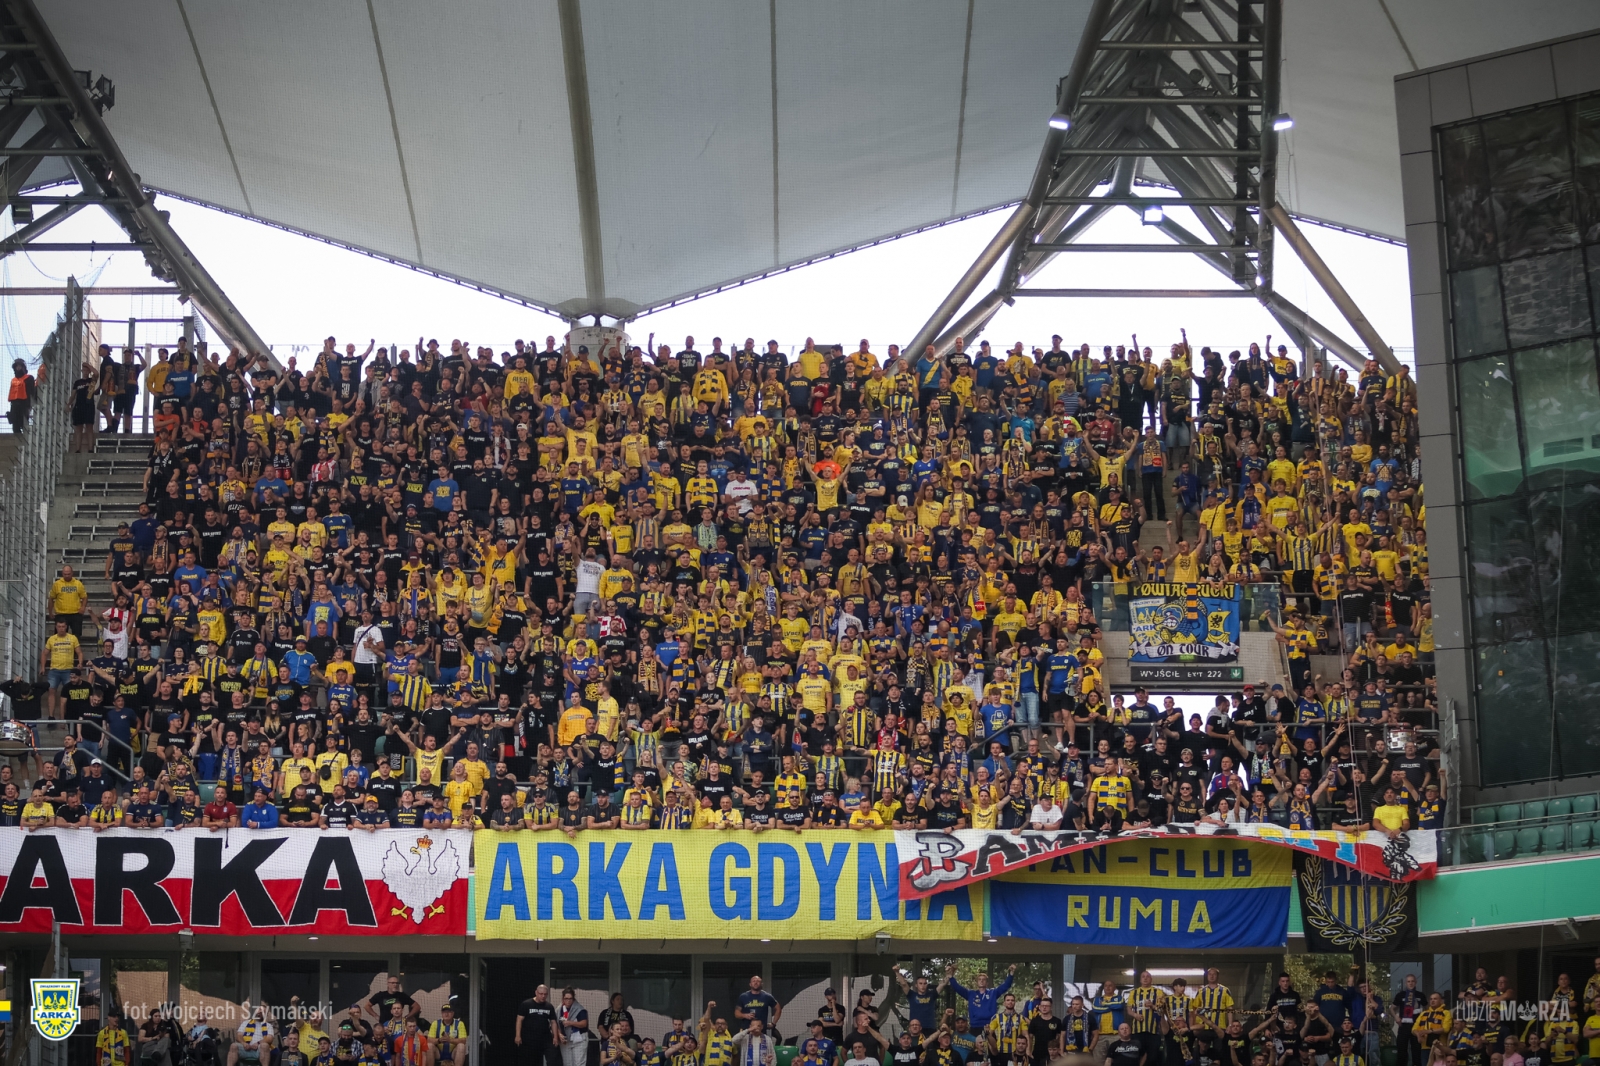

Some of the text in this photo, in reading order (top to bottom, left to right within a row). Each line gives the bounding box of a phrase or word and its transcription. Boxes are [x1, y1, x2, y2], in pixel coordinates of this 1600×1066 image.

[1140, 669, 1180, 678] WYJŚCIE
[1207, 670, 1222, 678] 222
[0, 835, 378, 928] ARKA
[484, 842, 974, 921] ARKA GDYN
[1029, 848, 1252, 878] AN-CLUB
[1067, 894, 1213, 933] RUMIA
